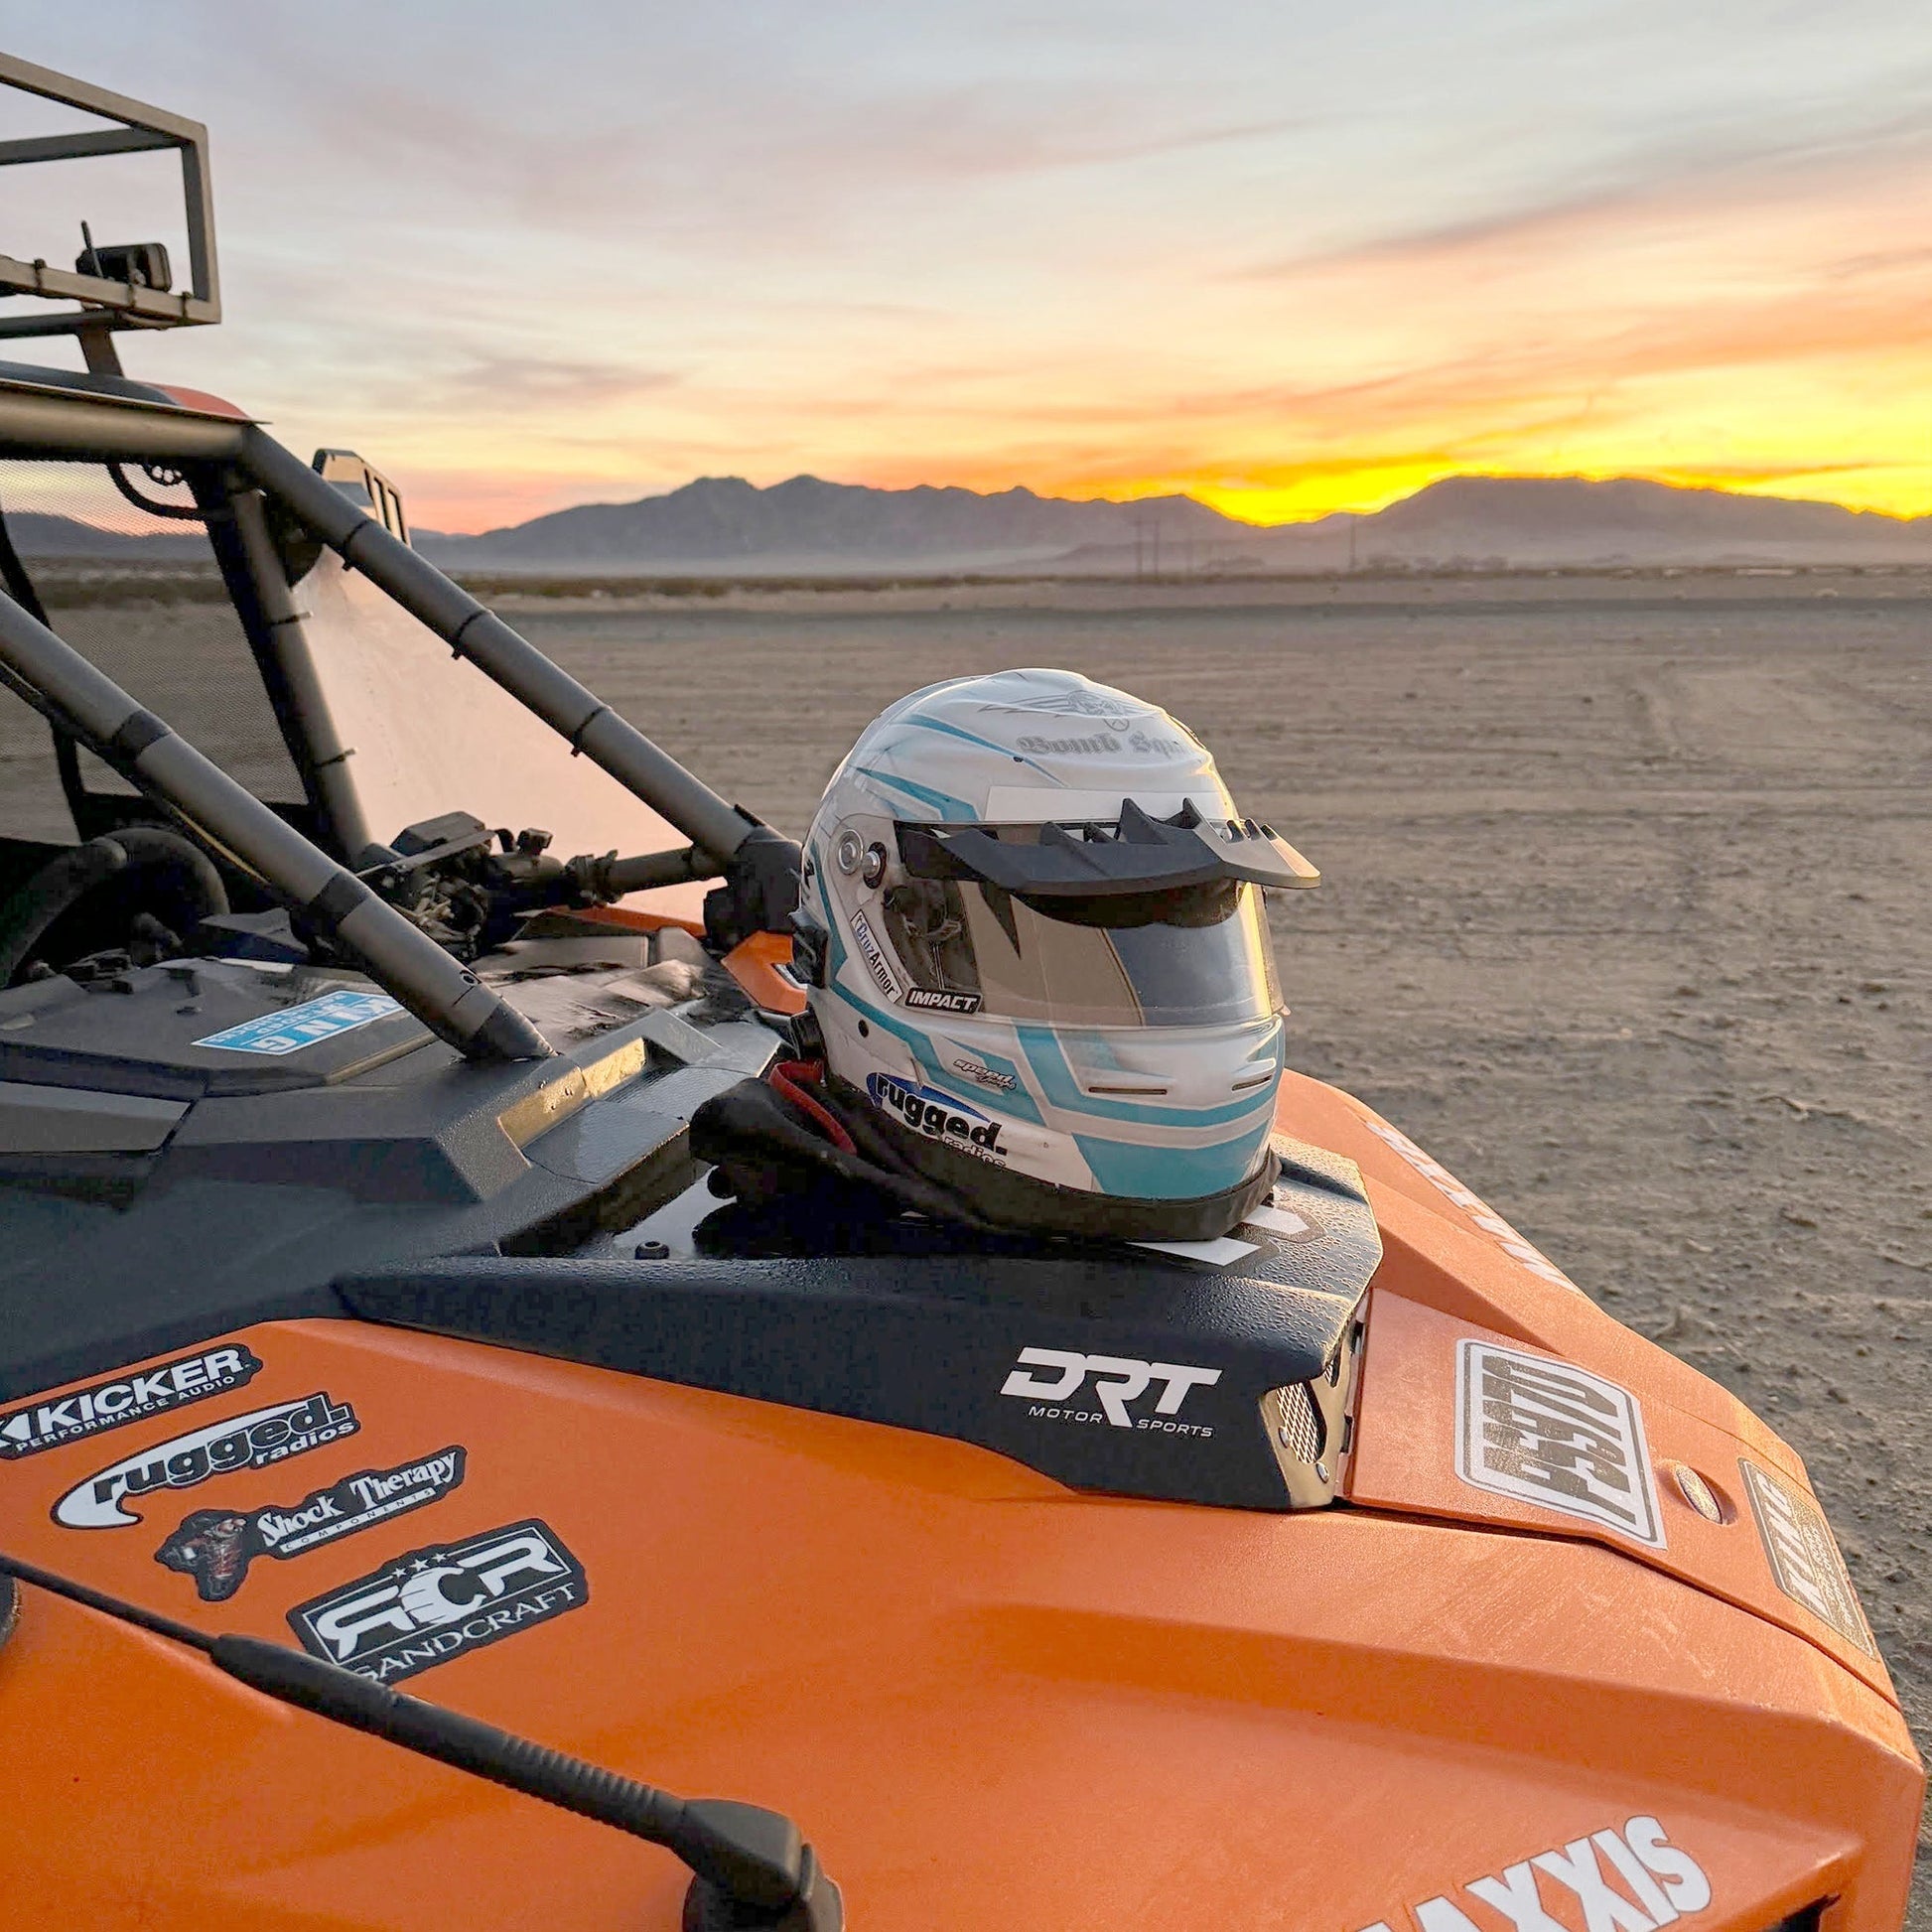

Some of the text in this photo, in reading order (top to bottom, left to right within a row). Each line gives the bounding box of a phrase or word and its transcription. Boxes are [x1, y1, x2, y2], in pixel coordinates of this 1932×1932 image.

[248, 996, 398, 1051] KING
[907, 991, 978, 1011] IMPACT
[16, 1375, 235, 1452] PERFORMANCE AUDIO
[37, 1348, 245, 1436] KICKER
[1000, 1346, 1223, 1428] DRT
[1028, 1405, 1214, 1438] MOTOR SPORTS
[255, 1422, 355, 1464] radios
[256, 1450, 458, 1548] Shock Therapy
[286, 1490, 432, 1550] COMPONENTS
[1754, 1470, 1832, 1618] KING
[351, 1583, 577, 1682] SANDCRAFT
